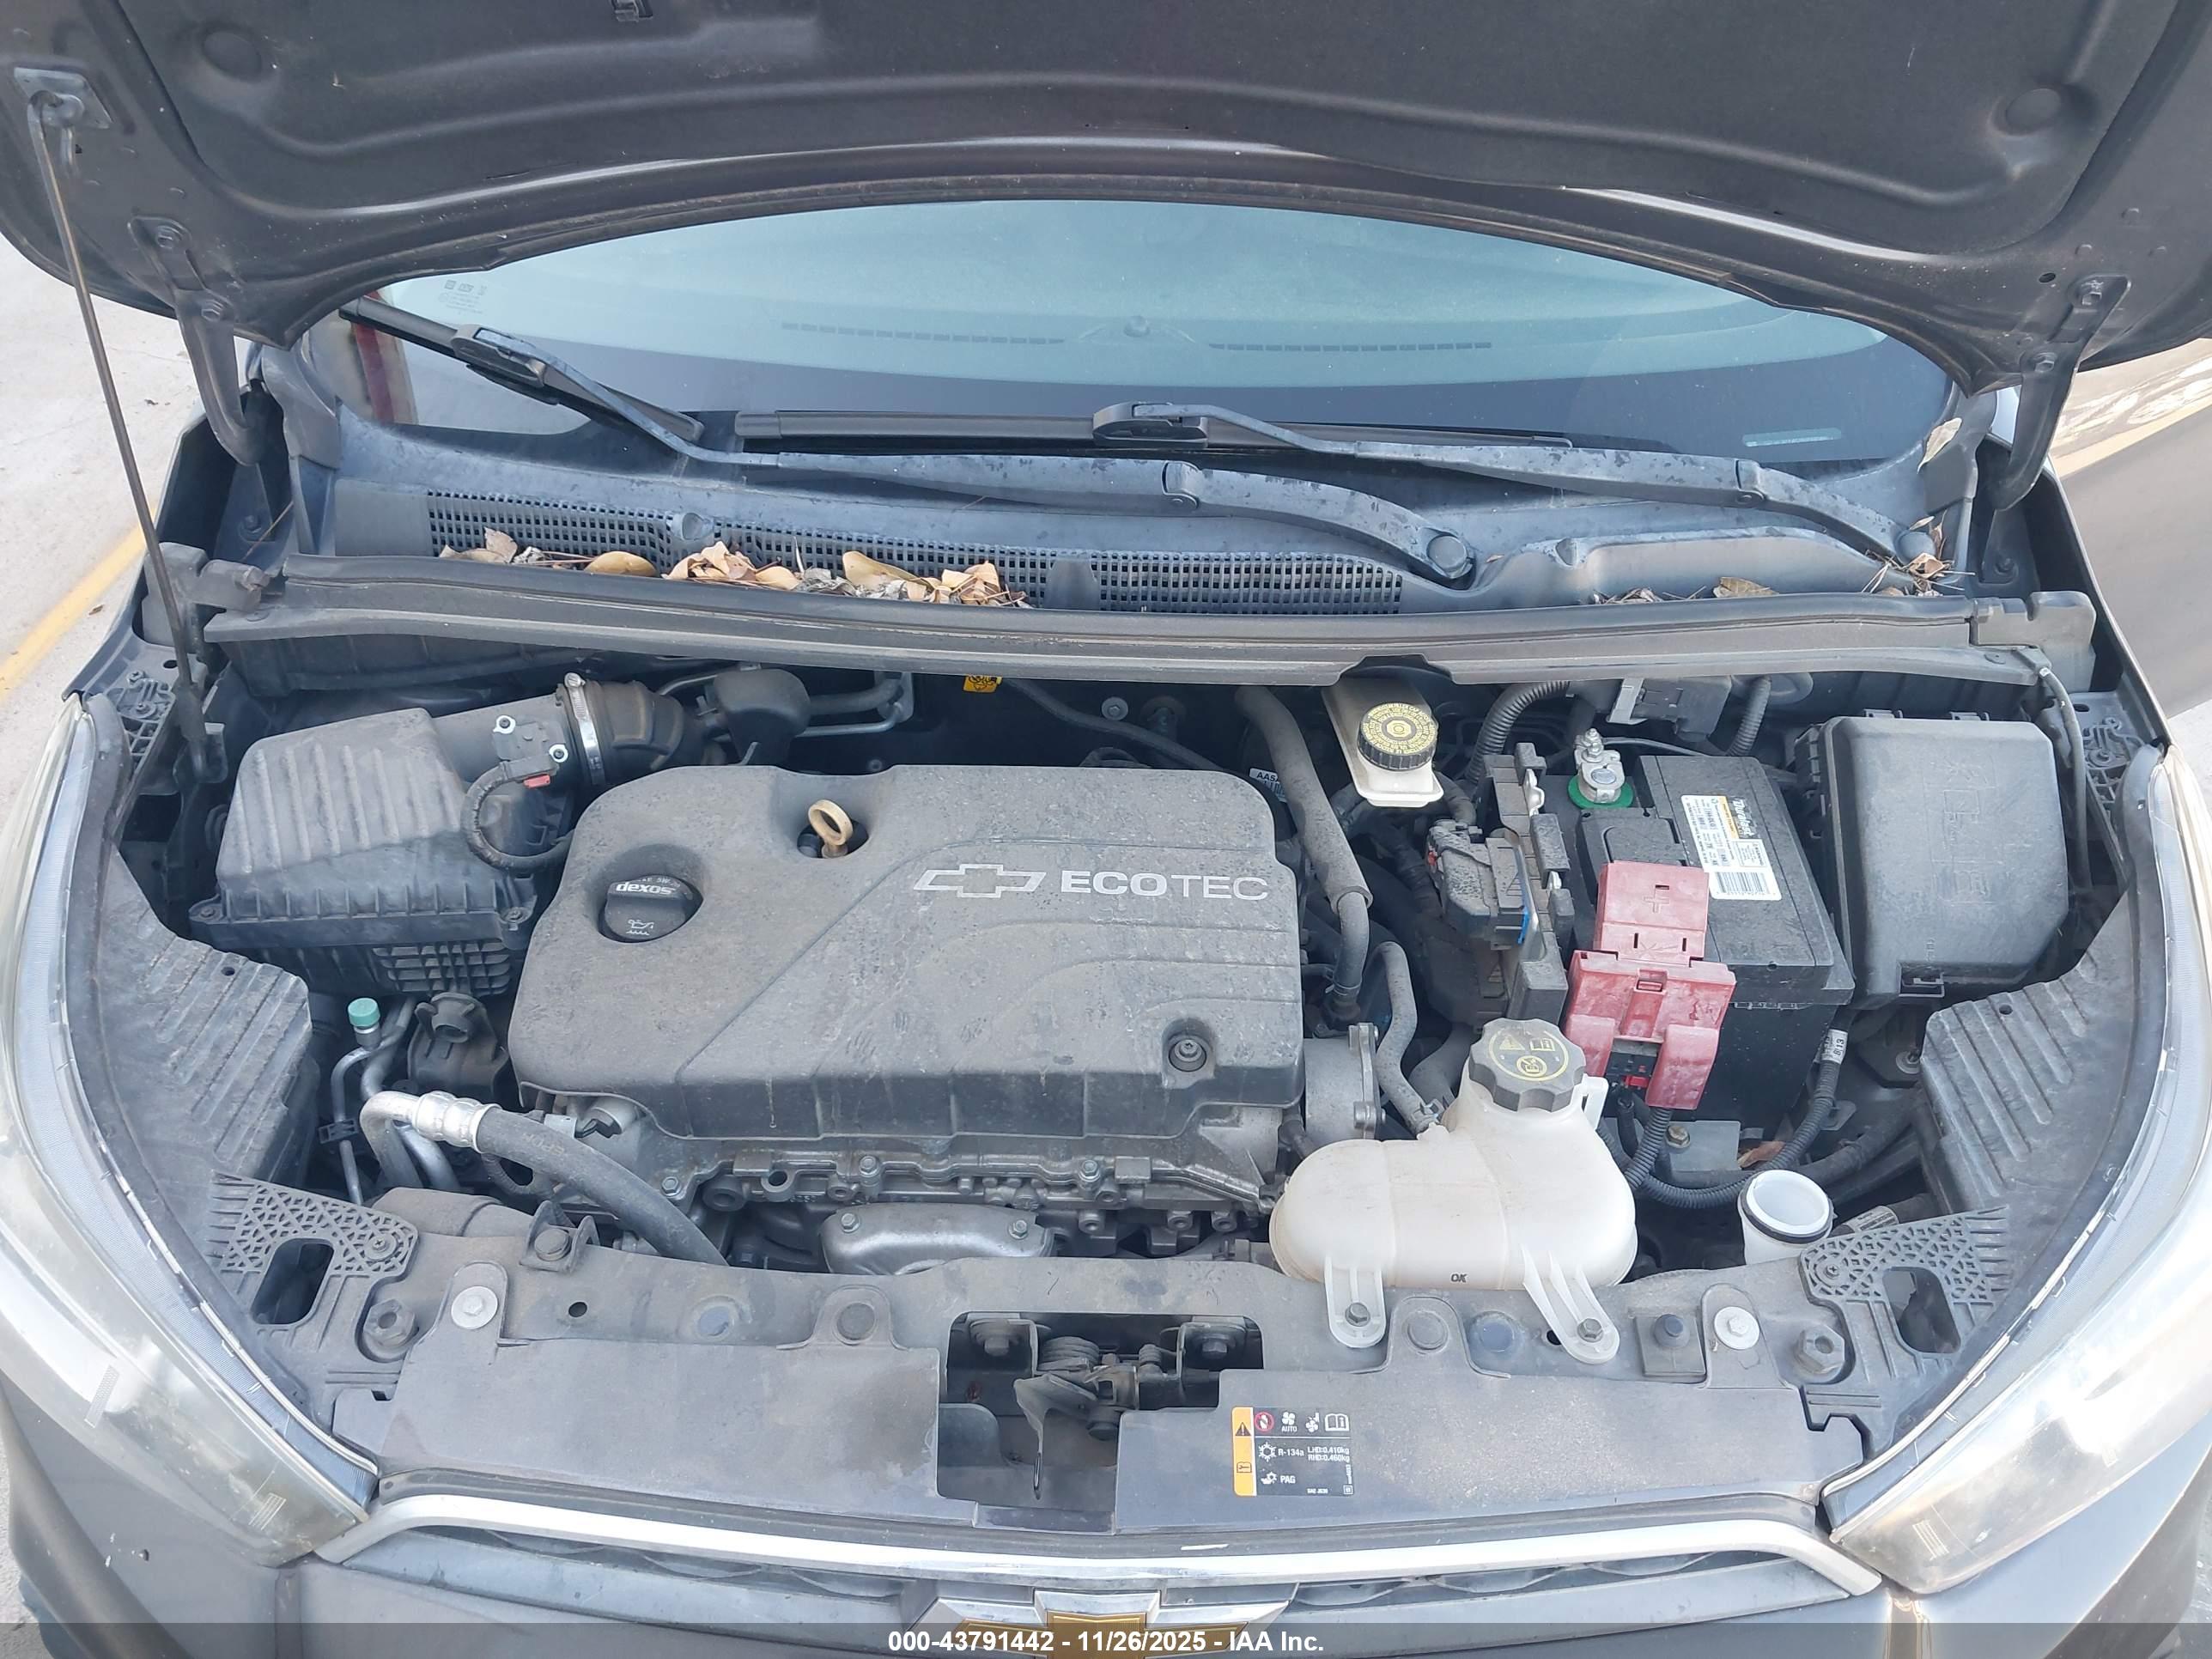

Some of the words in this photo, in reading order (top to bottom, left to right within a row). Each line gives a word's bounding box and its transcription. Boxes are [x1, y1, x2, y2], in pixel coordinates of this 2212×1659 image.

[1732, 799, 1754, 836] Duralast
[616, 882, 677, 894] dexos
[1060, 870, 1269, 901] ECOTEC
[1451, 1273, 1468, 1283] OK
[1278, 1448, 1304, 1457] R-134a
[1280, 1475, 1296, 1484] PAG
